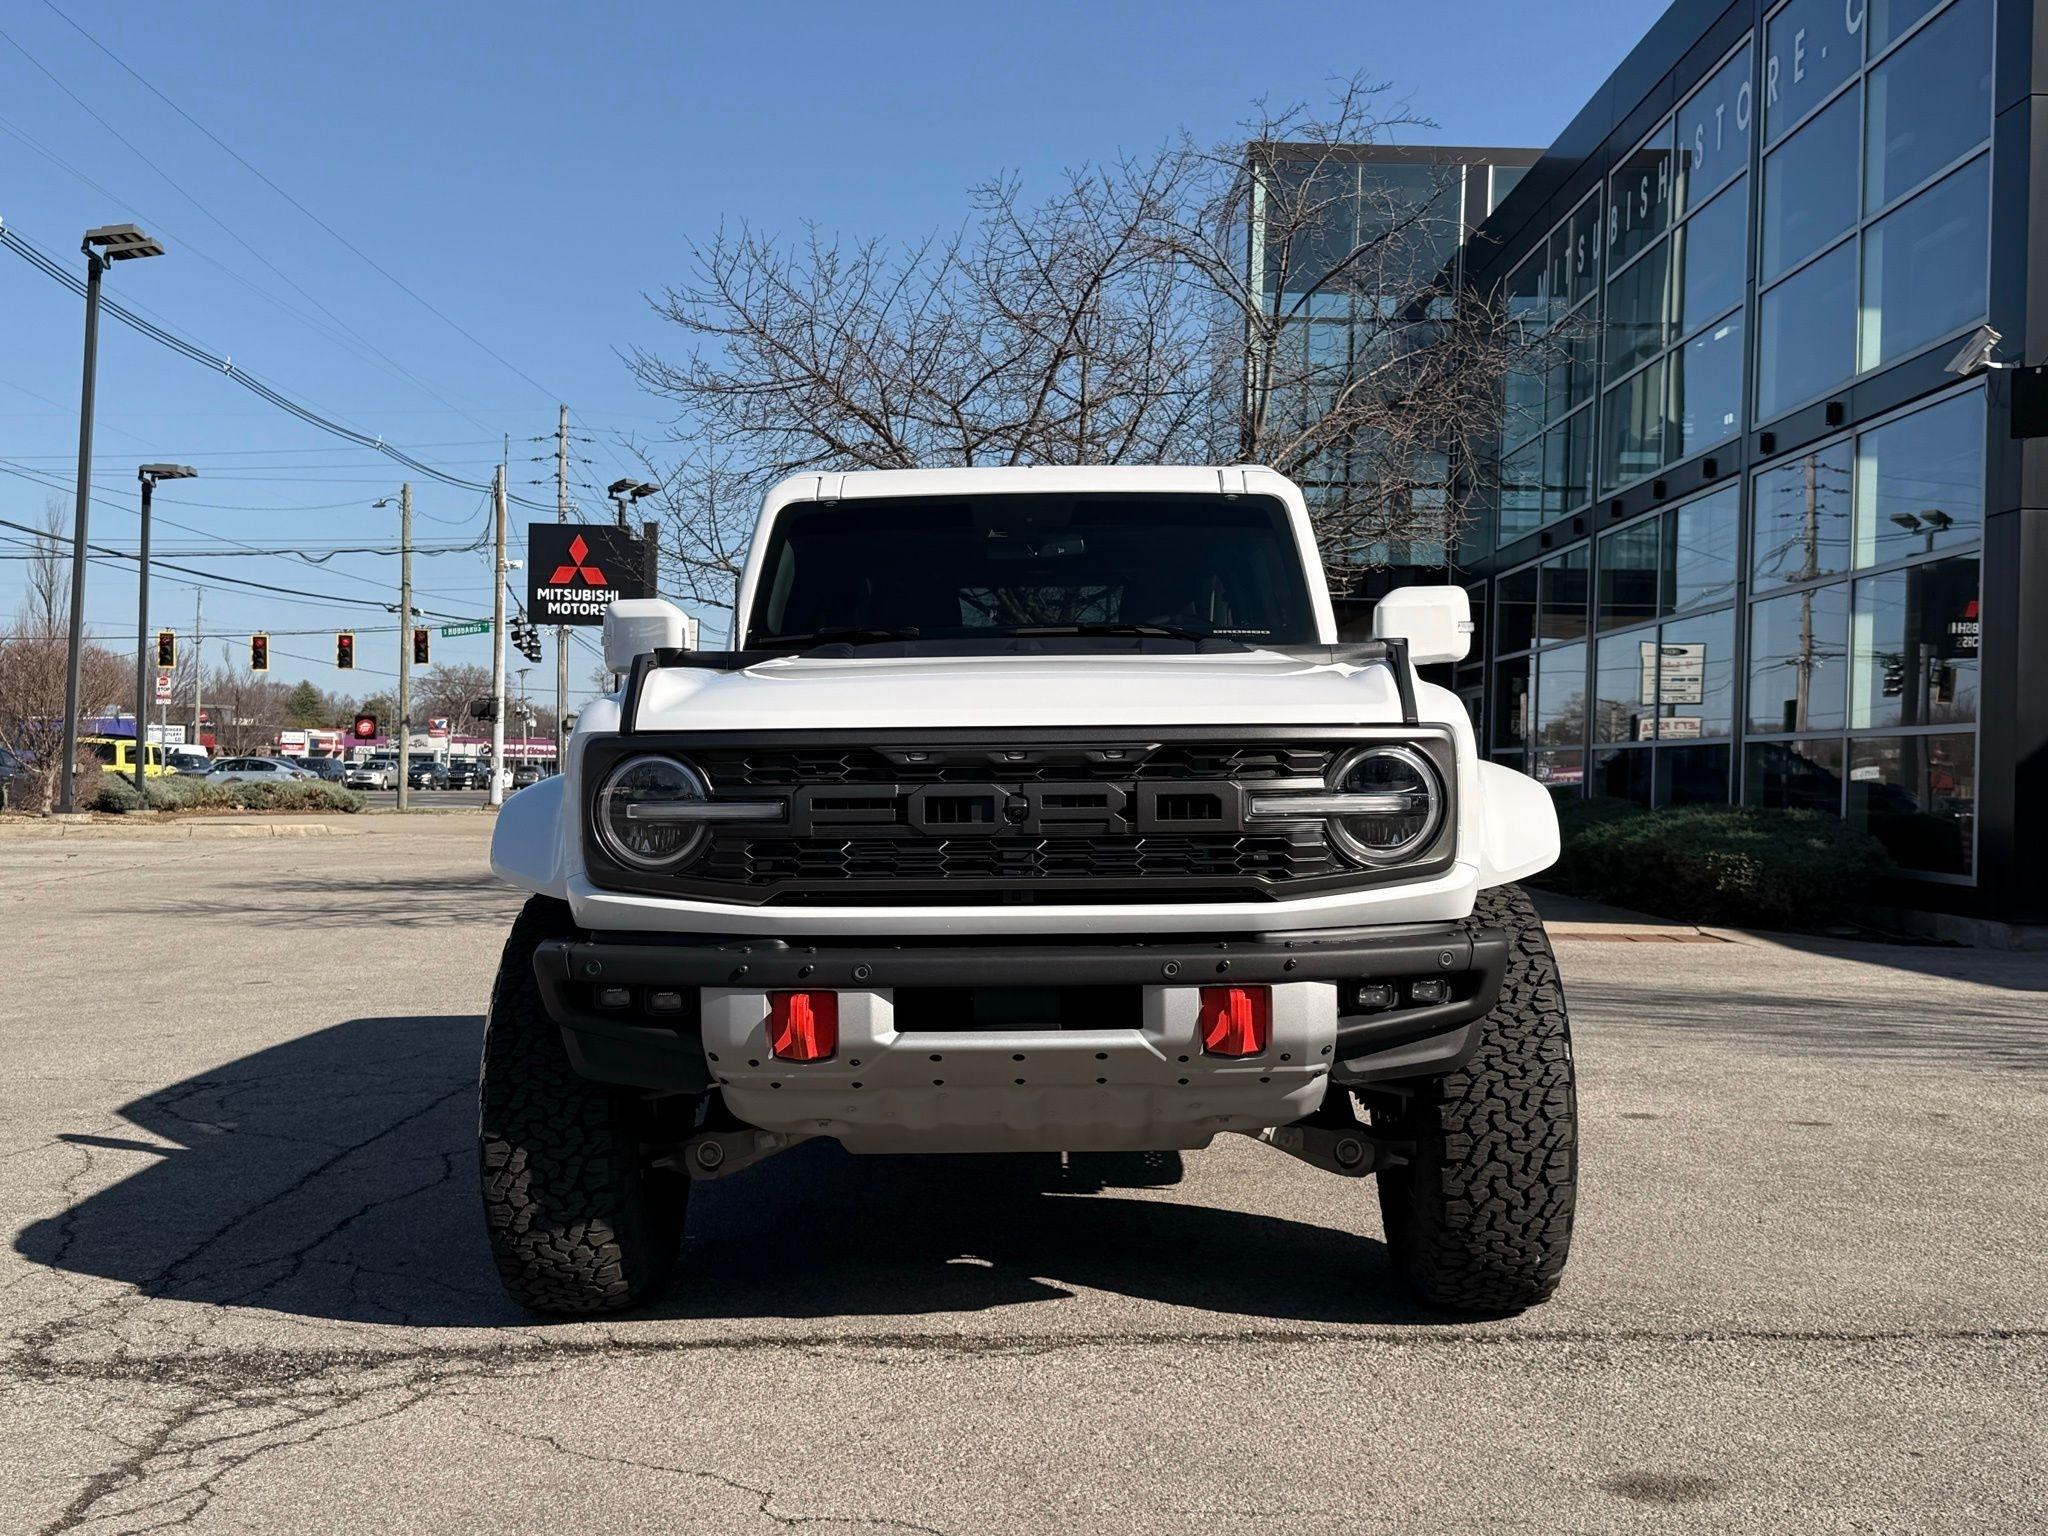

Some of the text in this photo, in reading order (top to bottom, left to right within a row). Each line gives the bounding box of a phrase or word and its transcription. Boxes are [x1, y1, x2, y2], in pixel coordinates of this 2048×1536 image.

[537, 588, 619, 601] MITSUBISHI
[547, 602, 608, 616] MOTORS
[792, 781, 1243, 836] FORD
